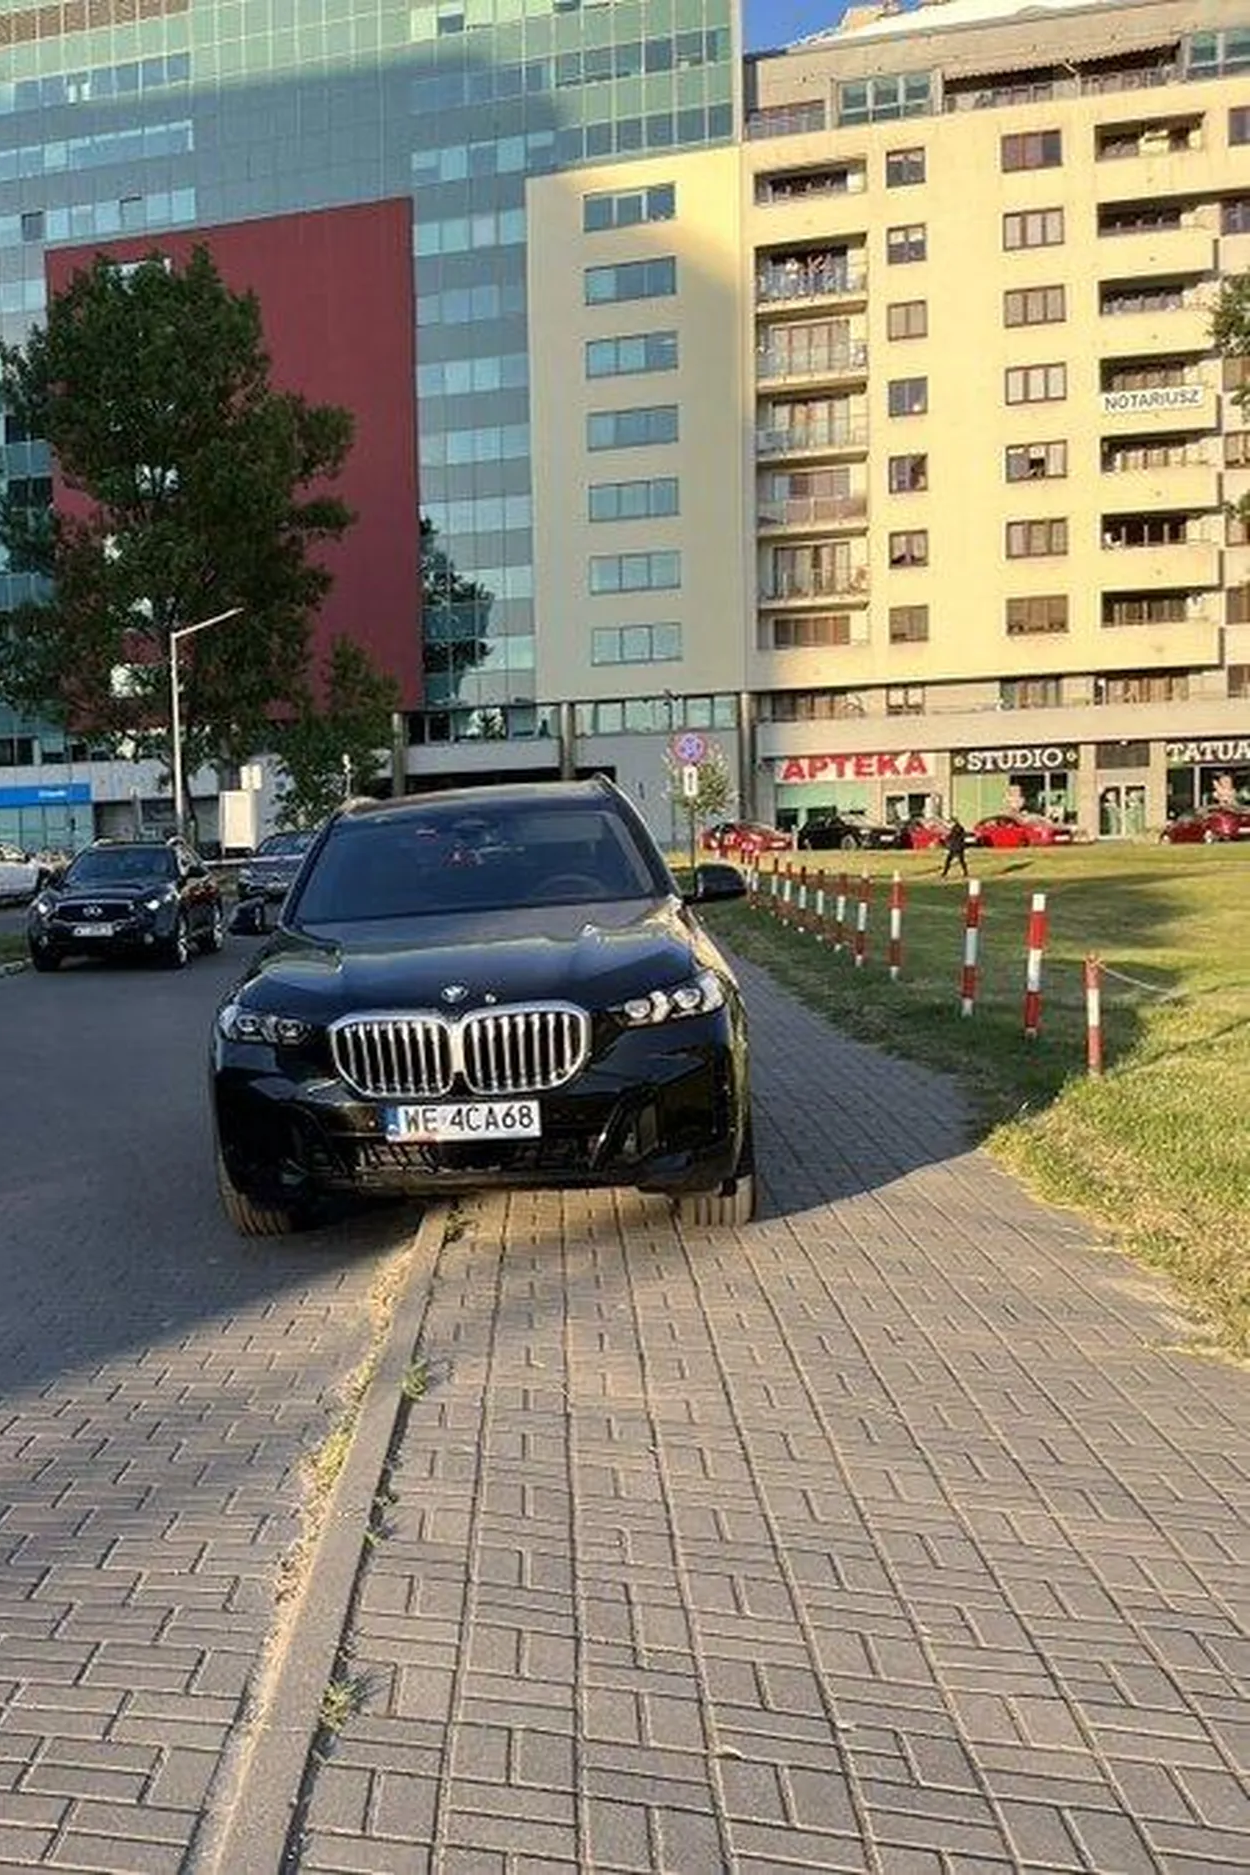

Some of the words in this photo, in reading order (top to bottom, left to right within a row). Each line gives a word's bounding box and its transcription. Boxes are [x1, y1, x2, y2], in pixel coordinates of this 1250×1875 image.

[1104, 389, 1199, 411] NOTARIUSZ
[967, 747, 1063, 771] STUDIO
[1166, 741, 1250, 762] TATUA
[782, 752, 928, 781] APTEKA
[404, 1108, 438, 1133] WE
[450, 1105, 533, 1131] 4CA68
